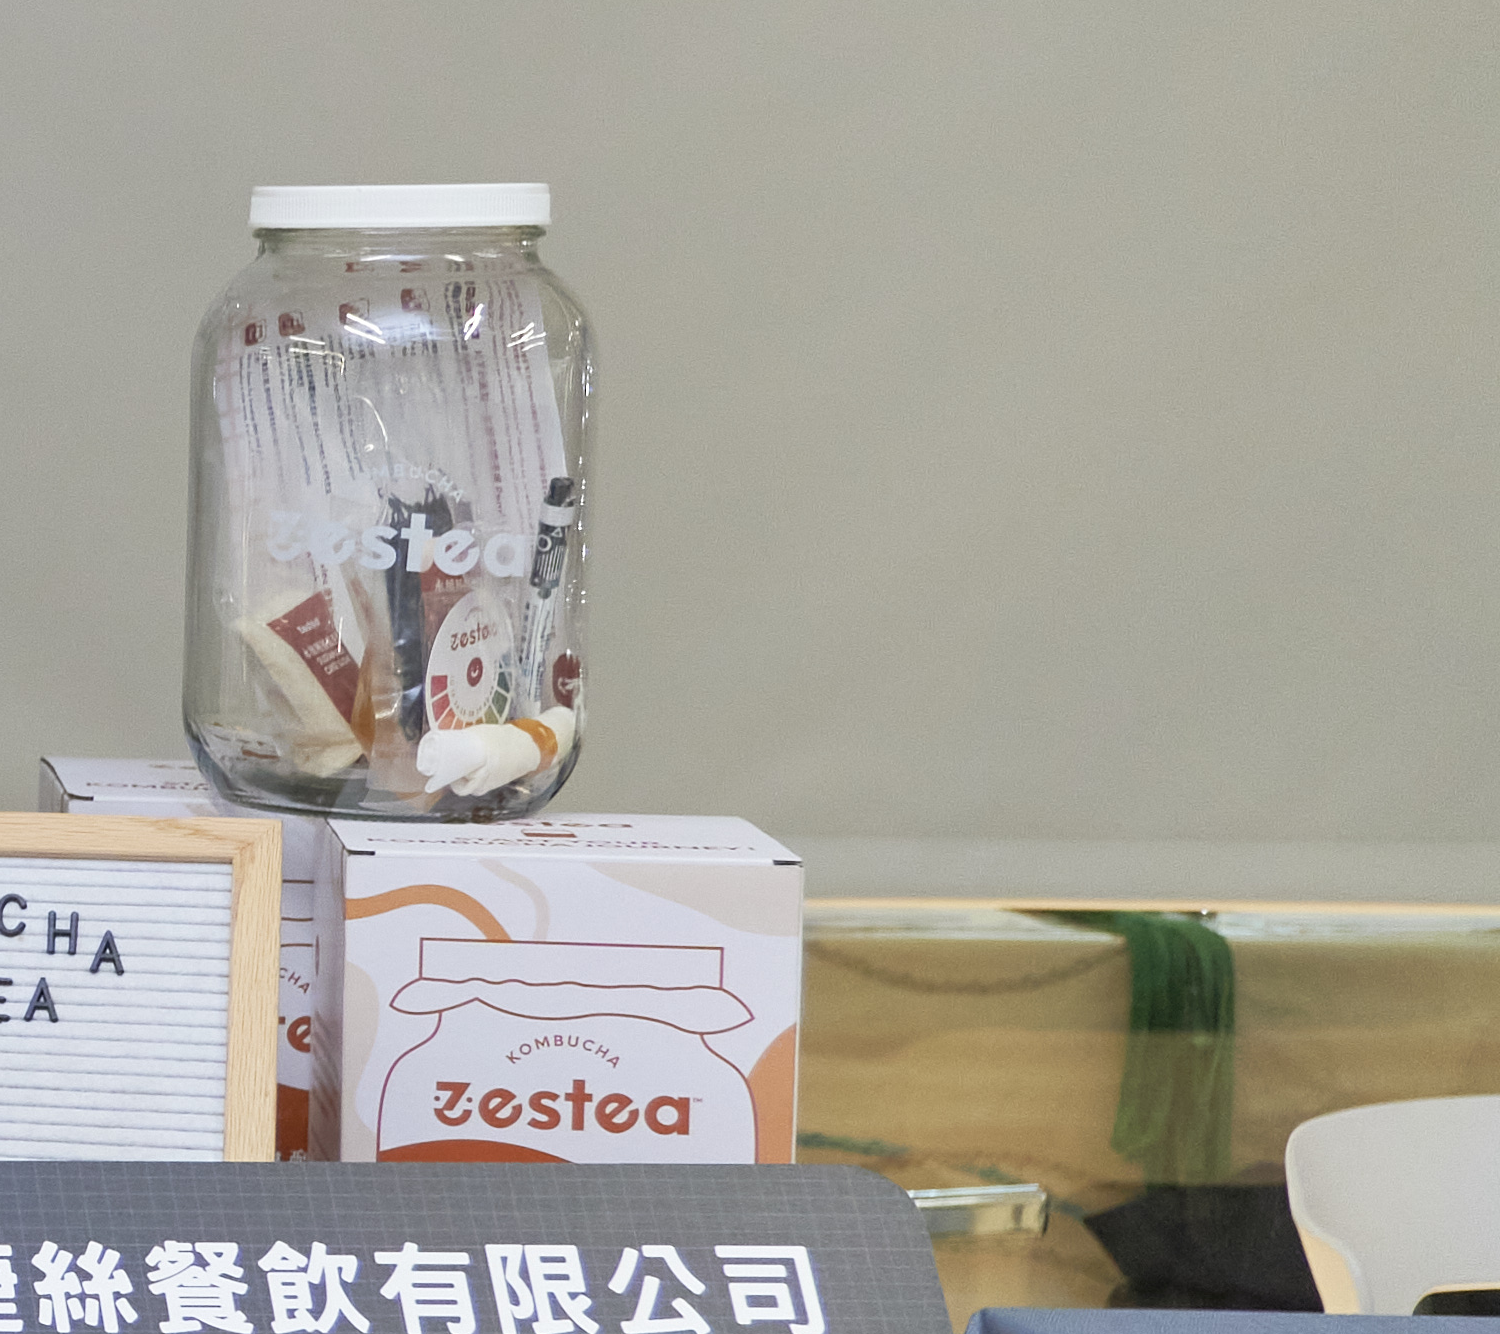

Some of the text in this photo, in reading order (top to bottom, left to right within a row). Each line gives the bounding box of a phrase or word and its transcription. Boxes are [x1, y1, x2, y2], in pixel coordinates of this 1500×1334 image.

[367, 837, 574, 848] KOMBUCHA
[505, 1034, 621, 1069] KOMBUCHA
[433, 1079, 690, 1136] zestea
